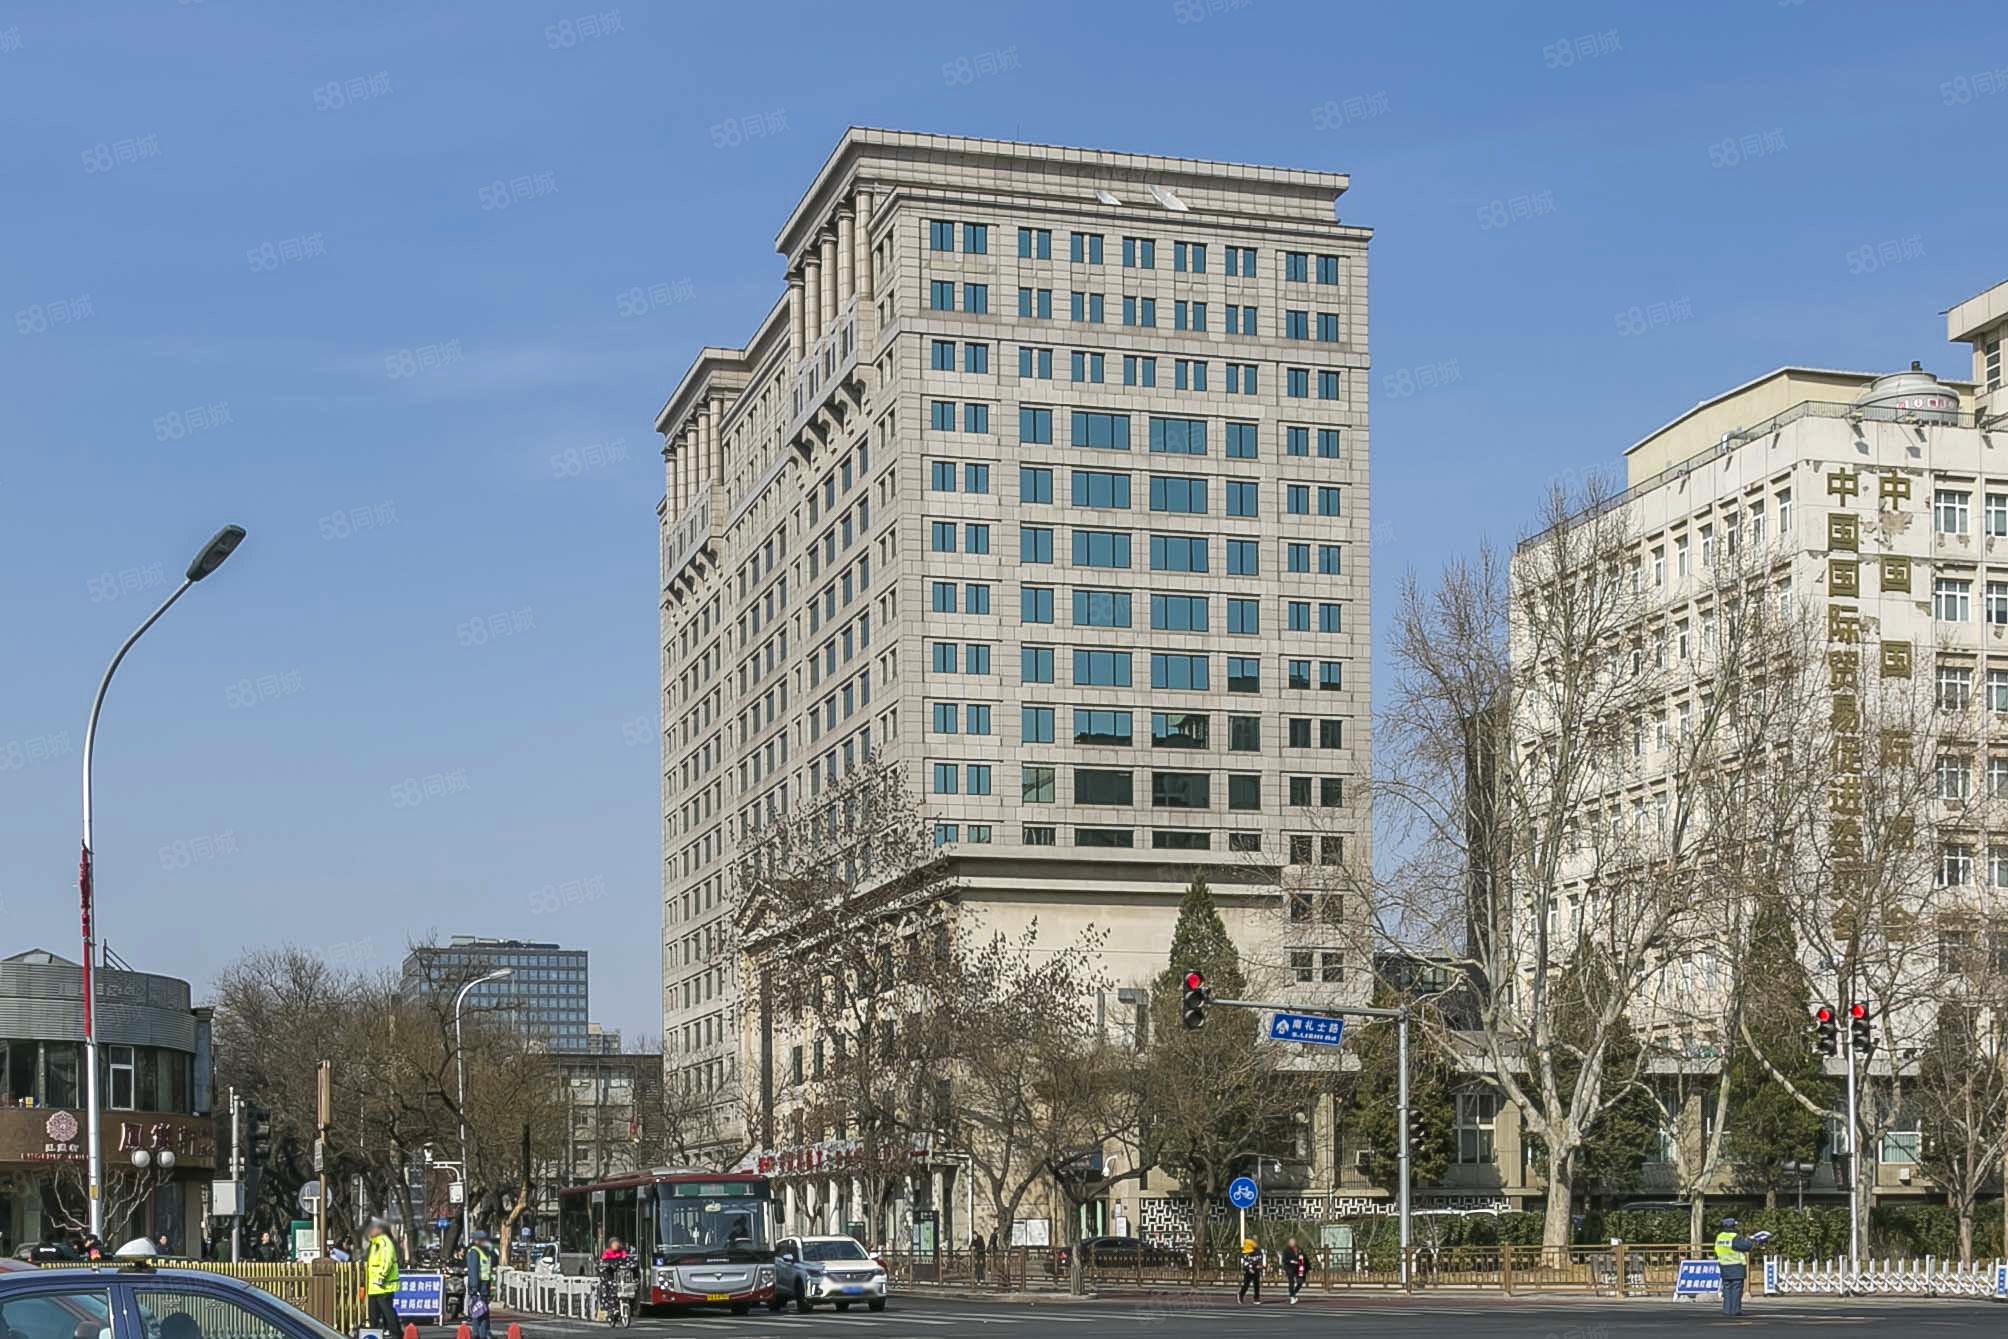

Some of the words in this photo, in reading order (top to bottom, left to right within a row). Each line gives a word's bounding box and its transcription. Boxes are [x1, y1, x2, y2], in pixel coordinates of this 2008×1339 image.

[1292, 1018, 1339, 1034] 南礼士路
[401, 1281, 440, 1292] 禁逆向行驶
